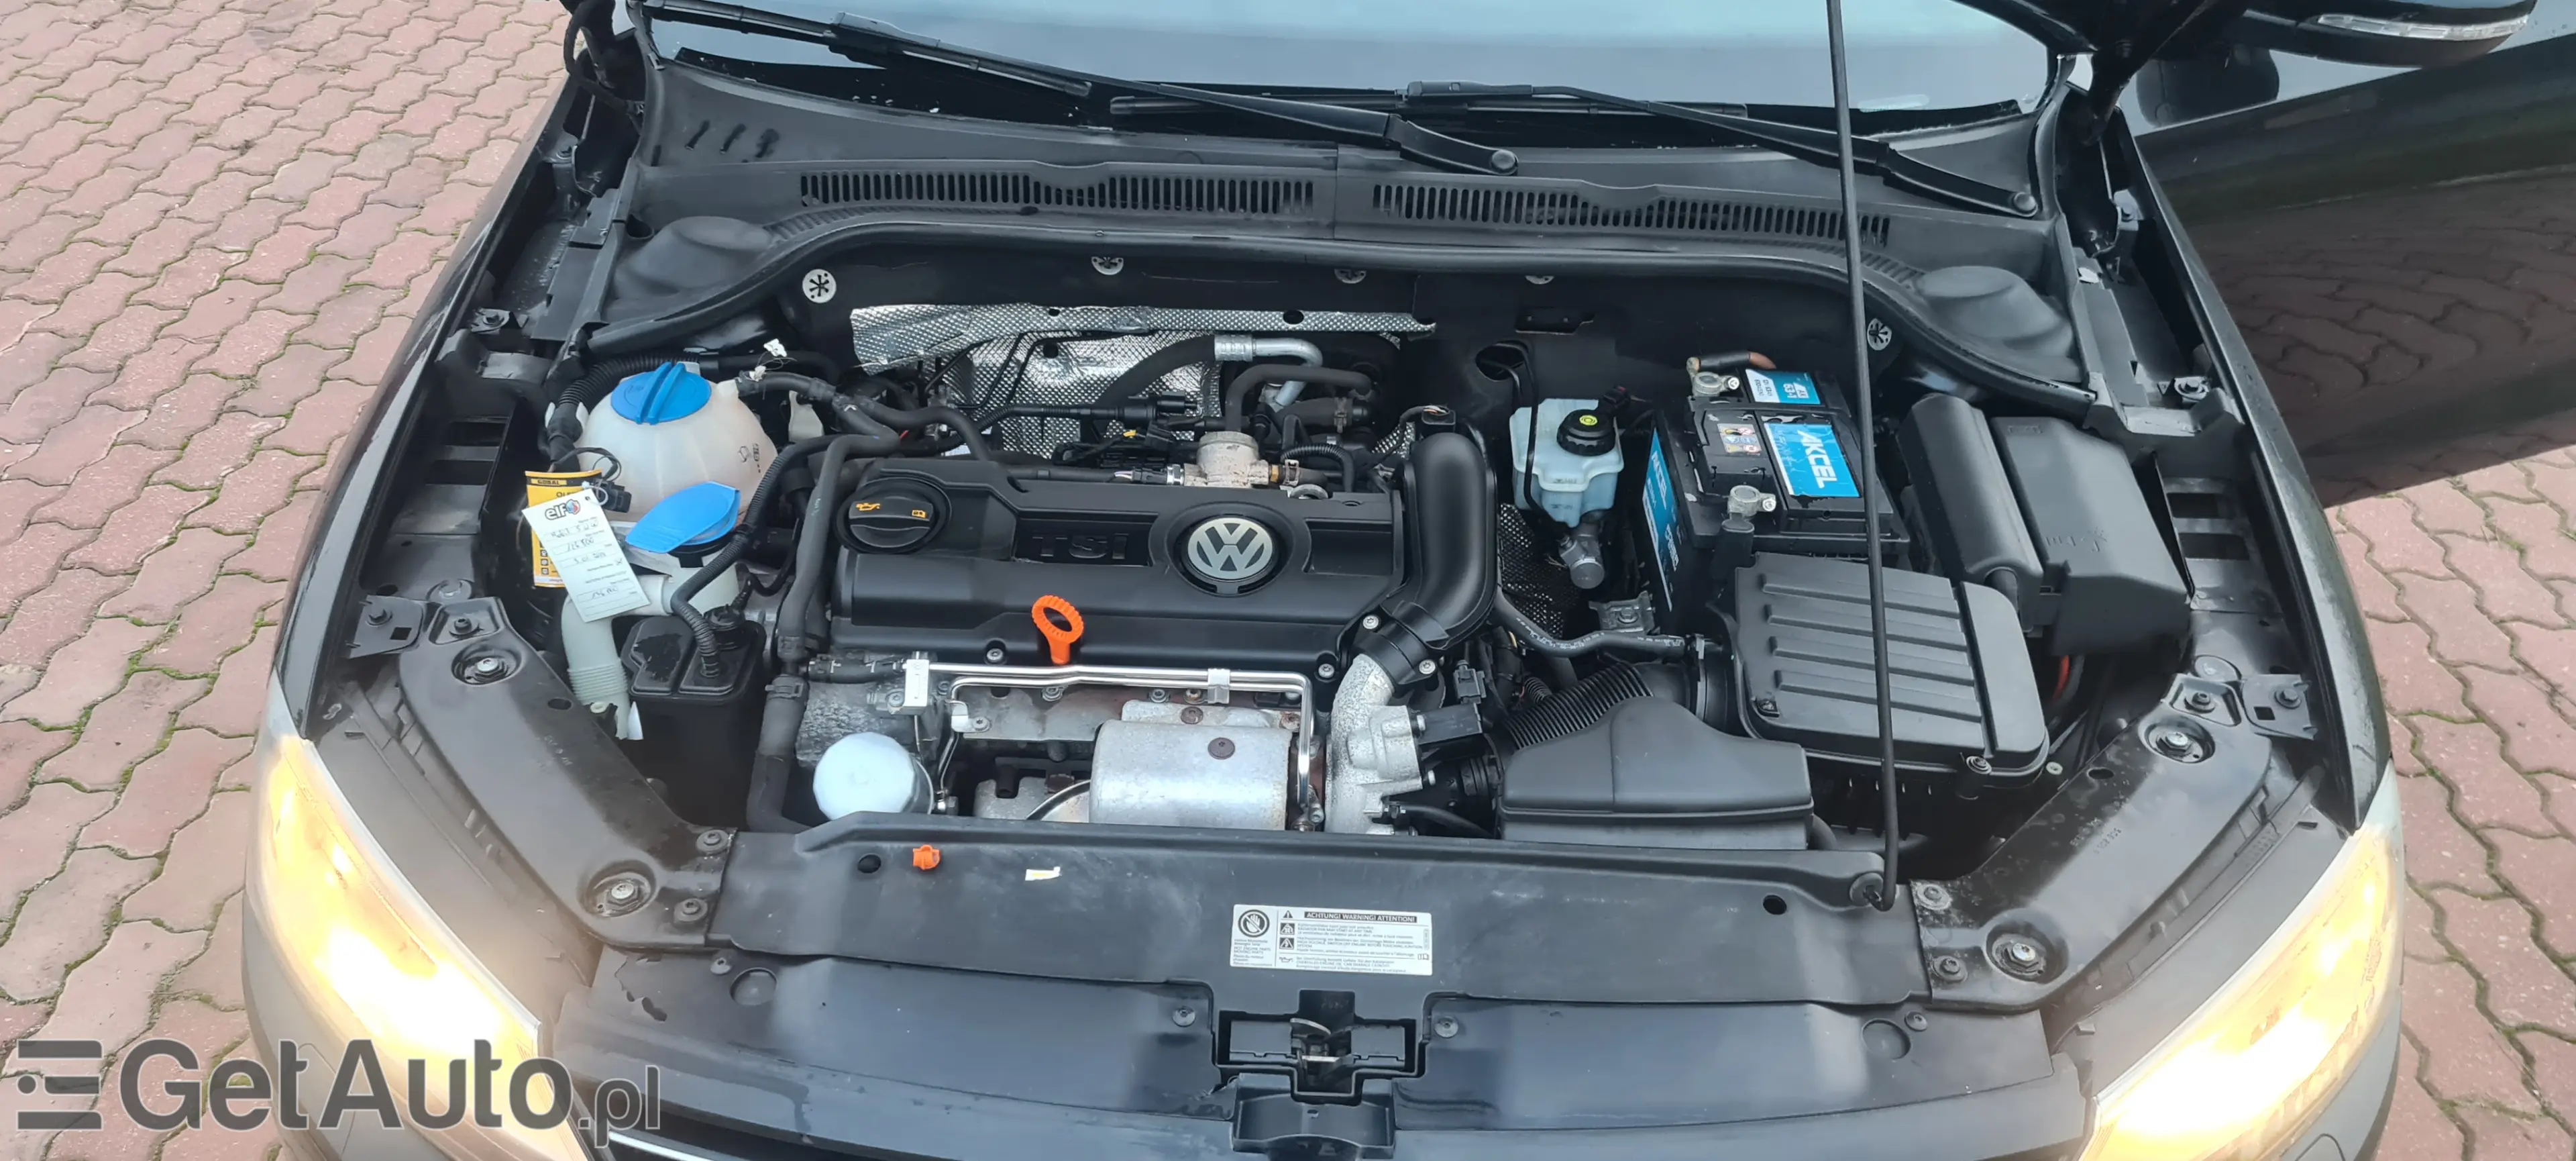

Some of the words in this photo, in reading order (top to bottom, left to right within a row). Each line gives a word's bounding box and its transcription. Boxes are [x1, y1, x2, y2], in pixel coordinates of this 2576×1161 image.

[1797, 430, 1838, 489] AKCEL
[545, 503, 566, 520] elf
[1031, 532, 1129, 560] TSI
[1342, 913, 1377, 921] WARNING!
[1377, 915, 1415, 923] ATTENTION!
